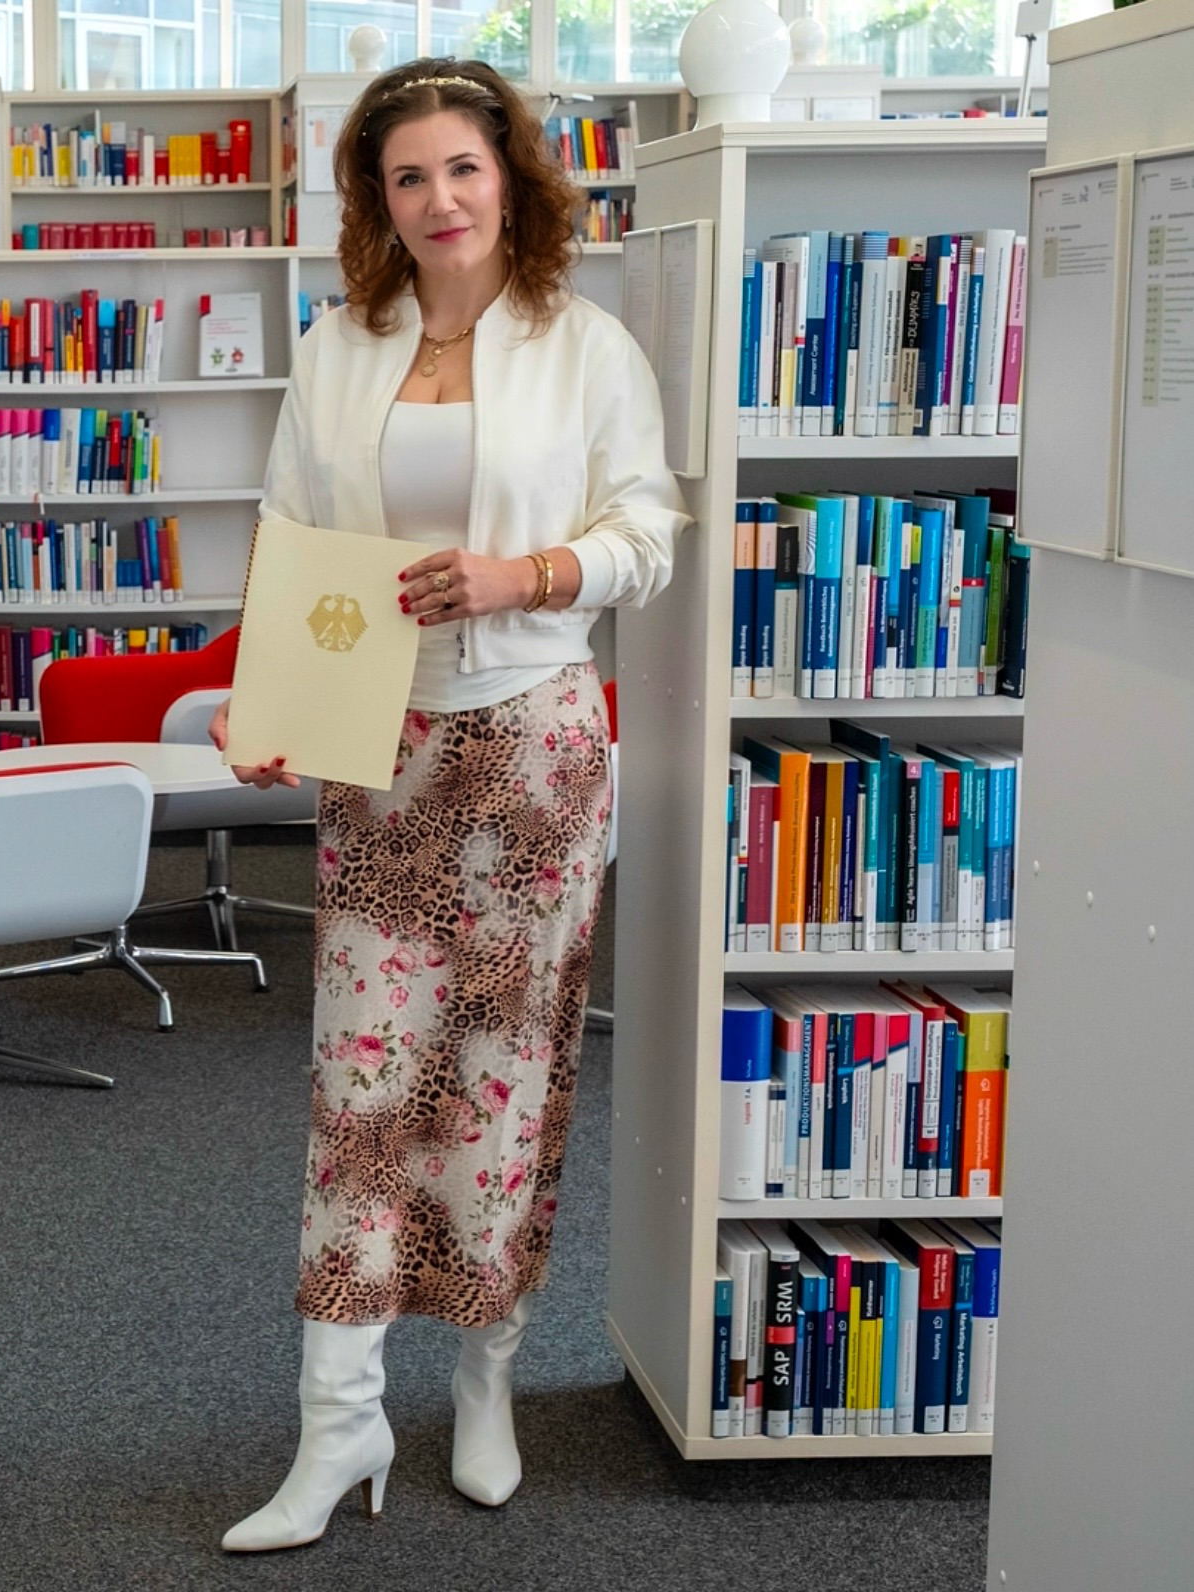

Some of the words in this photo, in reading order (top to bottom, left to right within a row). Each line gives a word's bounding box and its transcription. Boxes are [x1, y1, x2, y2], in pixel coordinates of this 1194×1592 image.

[811, 334, 819, 357] Center
[850, 322, 858, 347] Coaching
[820, 586, 828, 622] Betriebliches
[827, 586, 835, 656] Gesundheitsmanagement
[739, 625, 748, 649] Branding
[762, 625, 770, 649] Branding
[819, 624, 827, 652] Handbuch
[908, 813, 917, 867] lösungsfokussiert
[907, 889, 915, 904] Agile
[801, 1019, 812, 1134] PRODUKTIONSMANAGEMENT
[826, 1052, 835, 1109] Distributionslogistik
[841, 1078, 849, 1104] Logistik
[925, 1071, 933, 1098] Grundzüge
[776, 1281, 793, 1323] SRM
[866, 1280, 874, 1316] Kohlhammer
[932, 1333, 942, 1360] Marketing
[957, 1313, 967, 1350] Marketing
[773, 1351, 790, 1386] SAP
[955, 1351, 965, 1396] Arbeitsbuch
